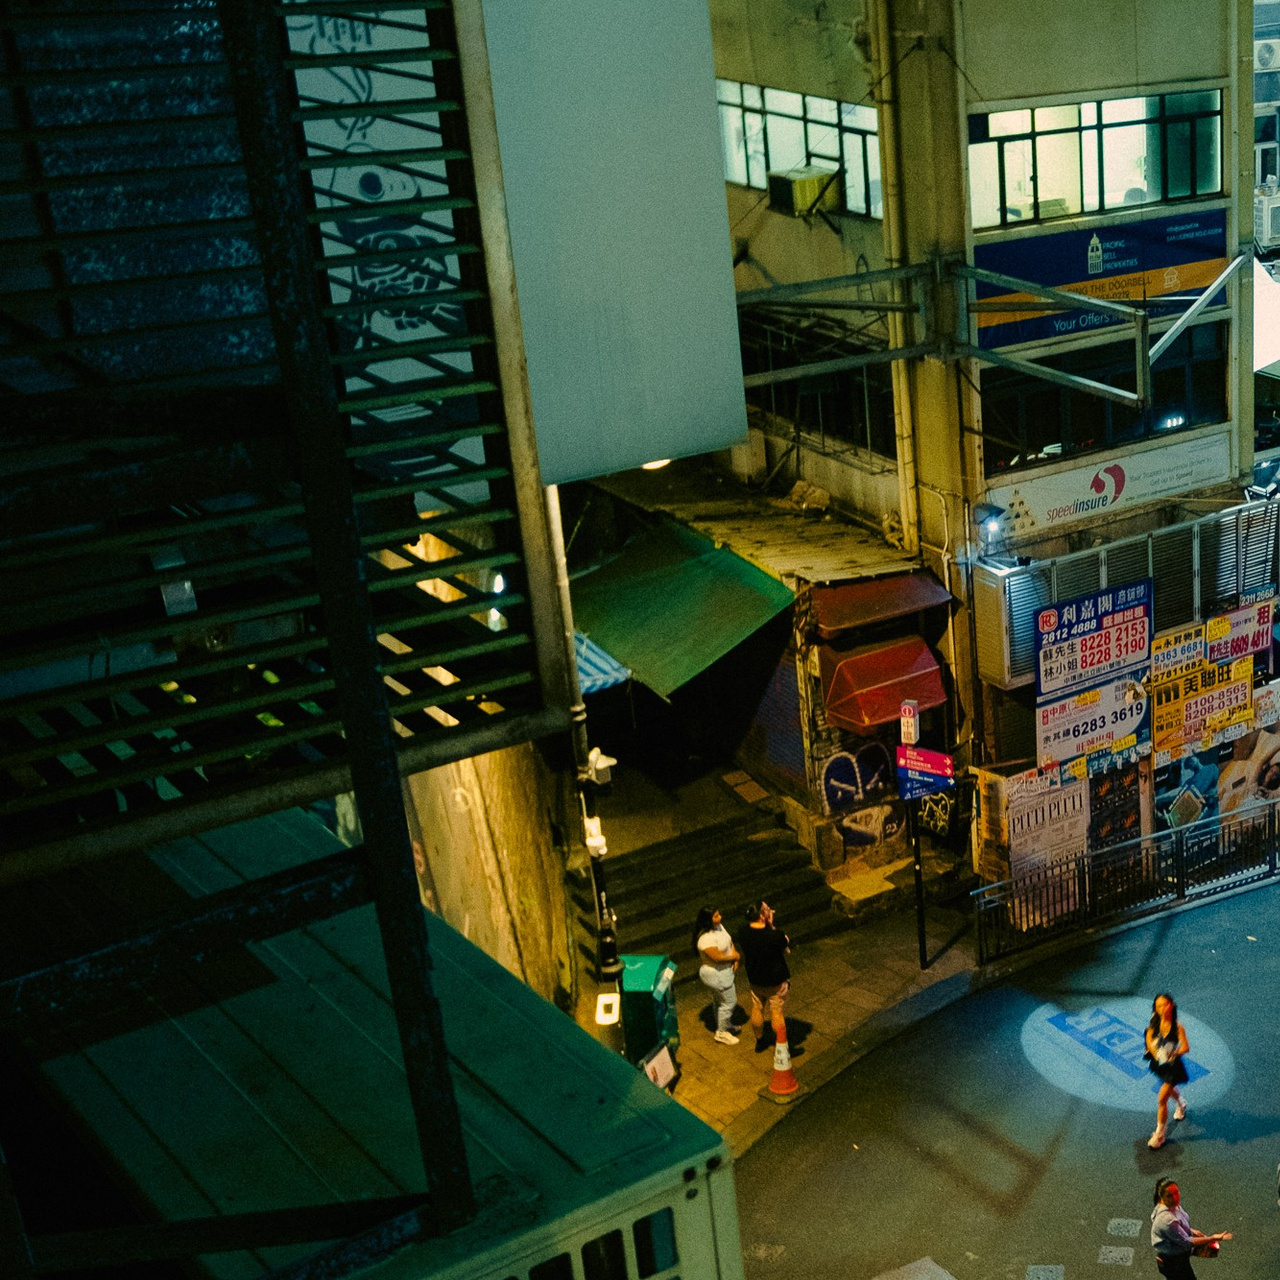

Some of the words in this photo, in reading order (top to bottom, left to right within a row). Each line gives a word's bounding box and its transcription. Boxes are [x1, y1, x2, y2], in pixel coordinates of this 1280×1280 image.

[1091, 283, 1106, 293] THE
[1108, 276, 1152, 291] DOORBELL
[1054, 319, 1076, 331] Your
[1079, 313, 1110, 327] Offers
[1046, 495, 1108, 523] speedinsure
[1241, 594, 1255, 606] 2311
[1257, 605, 1270, 625] 租
[1042, 628, 1068, 645] 2812
[1071, 619, 1097, 636] 4888
[1081, 631, 1110, 653] 8228
[1116, 620, 1146, 643] 2153
[1251, 626, 1269, 650] 4811
[1044, 658, 1078, 681] 林小姐
[1081, 647, 1110, 670] 8228
[1116, 636, 1146, 659] 3190
[1154, 647, 1177, 665] 9363
[1181, 640, 1203, 656] 6681
[1185, 681, 1248, 713] 8100-8565
[1185, 692, 1248, 723] 8208-0313
[1072, 716, 1106, 738] 6283
[1111, 702, 1143, 724] 3619
